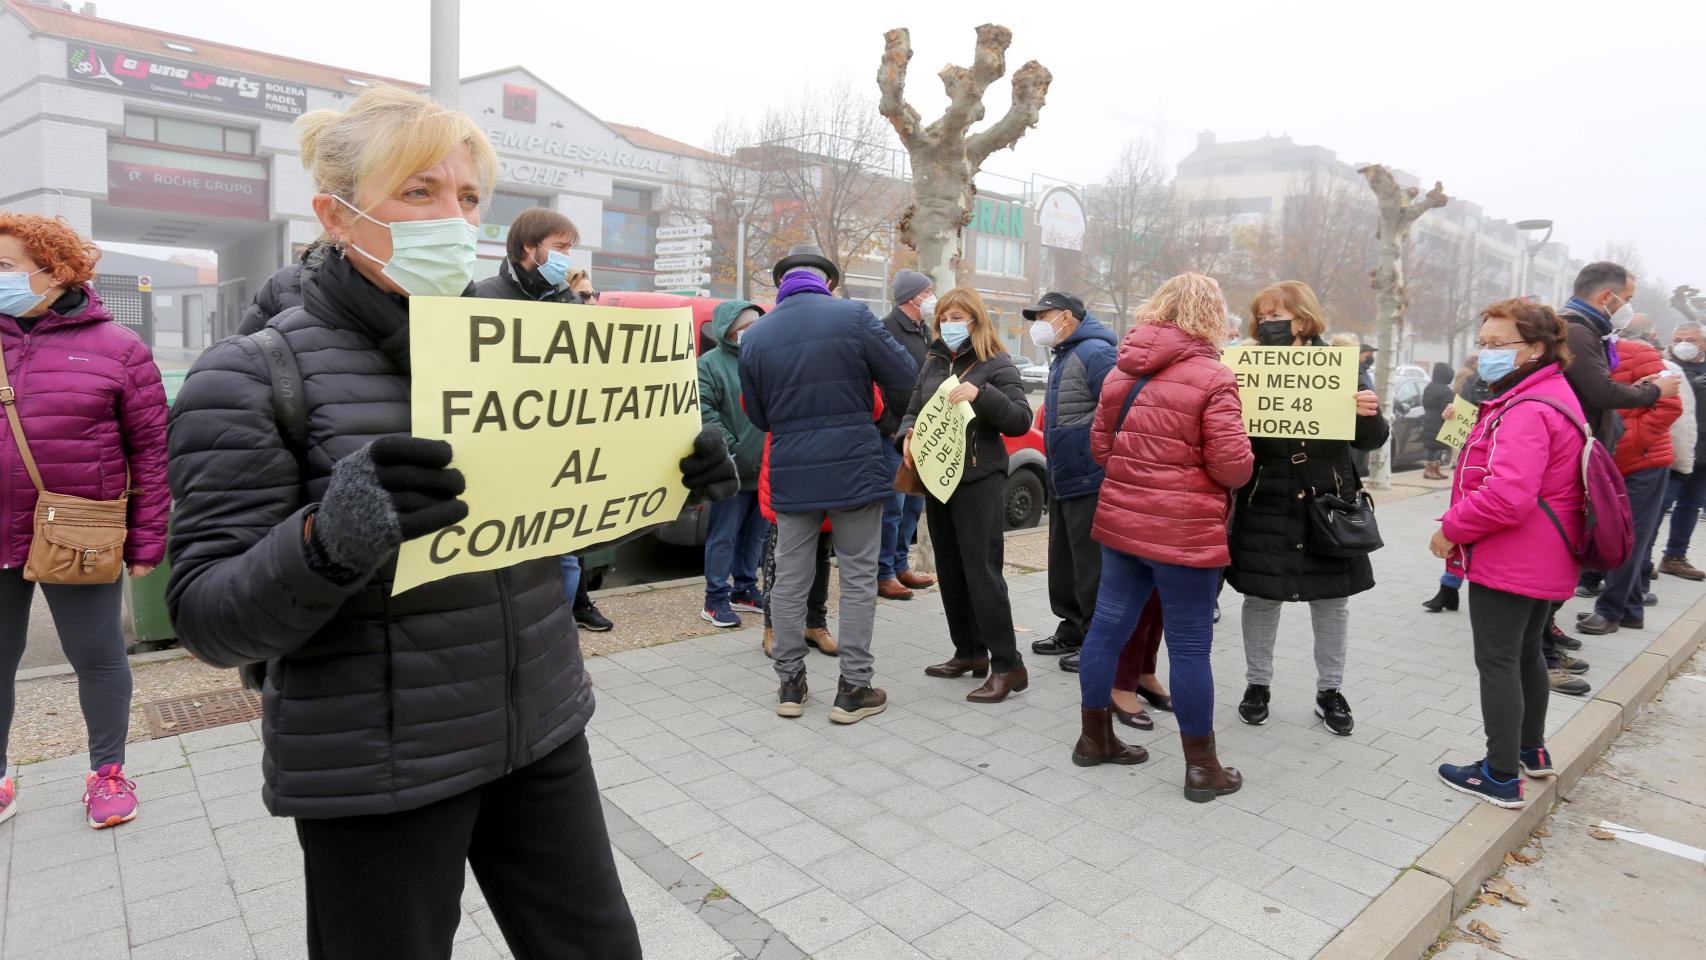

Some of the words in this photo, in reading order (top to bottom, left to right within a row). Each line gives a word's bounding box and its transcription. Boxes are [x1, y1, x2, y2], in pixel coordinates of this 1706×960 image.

[265, 83, 305, 97] BOLERA
[265, 92, 297, 106] PADEL
[490, 130, 667, 174] EMPRESARIAL
[154, 173, 200, 189] ROCHE
[205, 179, 253, 195] GRUPO
[469, 315, 696, 364] PLANTILLA
[1238, 348, 1342, 367] ATENCIÓN
[1235, 373, 1259, 388] EN
[1267, 374, 1340, 390] MENOS
[442, 379, 700, 434] FACULTATIVA
[916, 421, 928, 441] NO
[928, 412, 937, 424] A
[933, 395, 946, 413] LA
[1258, 396, 1284, 411] DE
[1291, 398, 1313, 412] 48
[918, 401, 954, 467] SATURACIO
[936, 444, 953, 463] DE
[948, 417, 959, 444] LAS
[1249, 419, 1320, 435] HORAS
[550, 447, 607, 488] AL
[429, 487, 668, 565] COMPLETO
